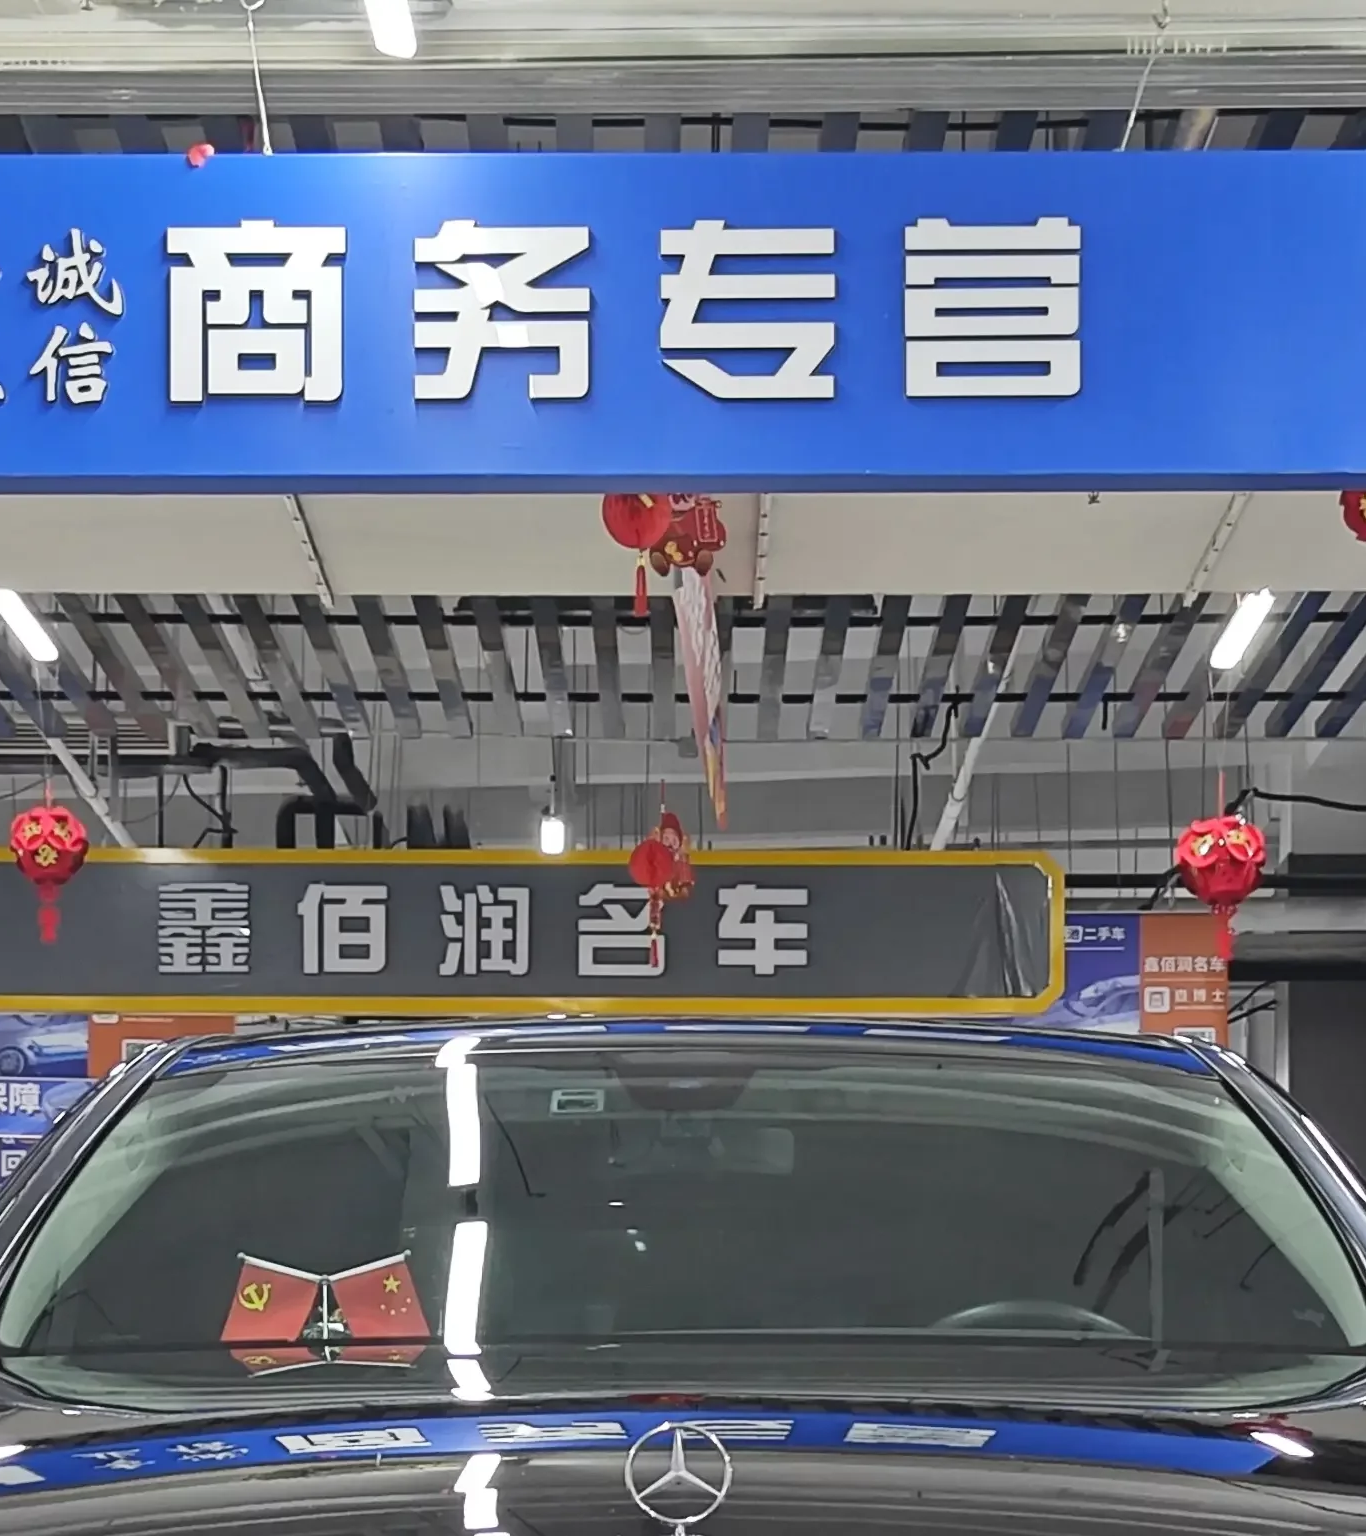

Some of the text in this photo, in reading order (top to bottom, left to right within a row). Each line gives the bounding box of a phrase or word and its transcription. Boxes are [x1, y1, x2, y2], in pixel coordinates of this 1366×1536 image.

[167, 217, 1081, 403] 商务专营
[157, 880, 809, 977] 鑫佰润名车
